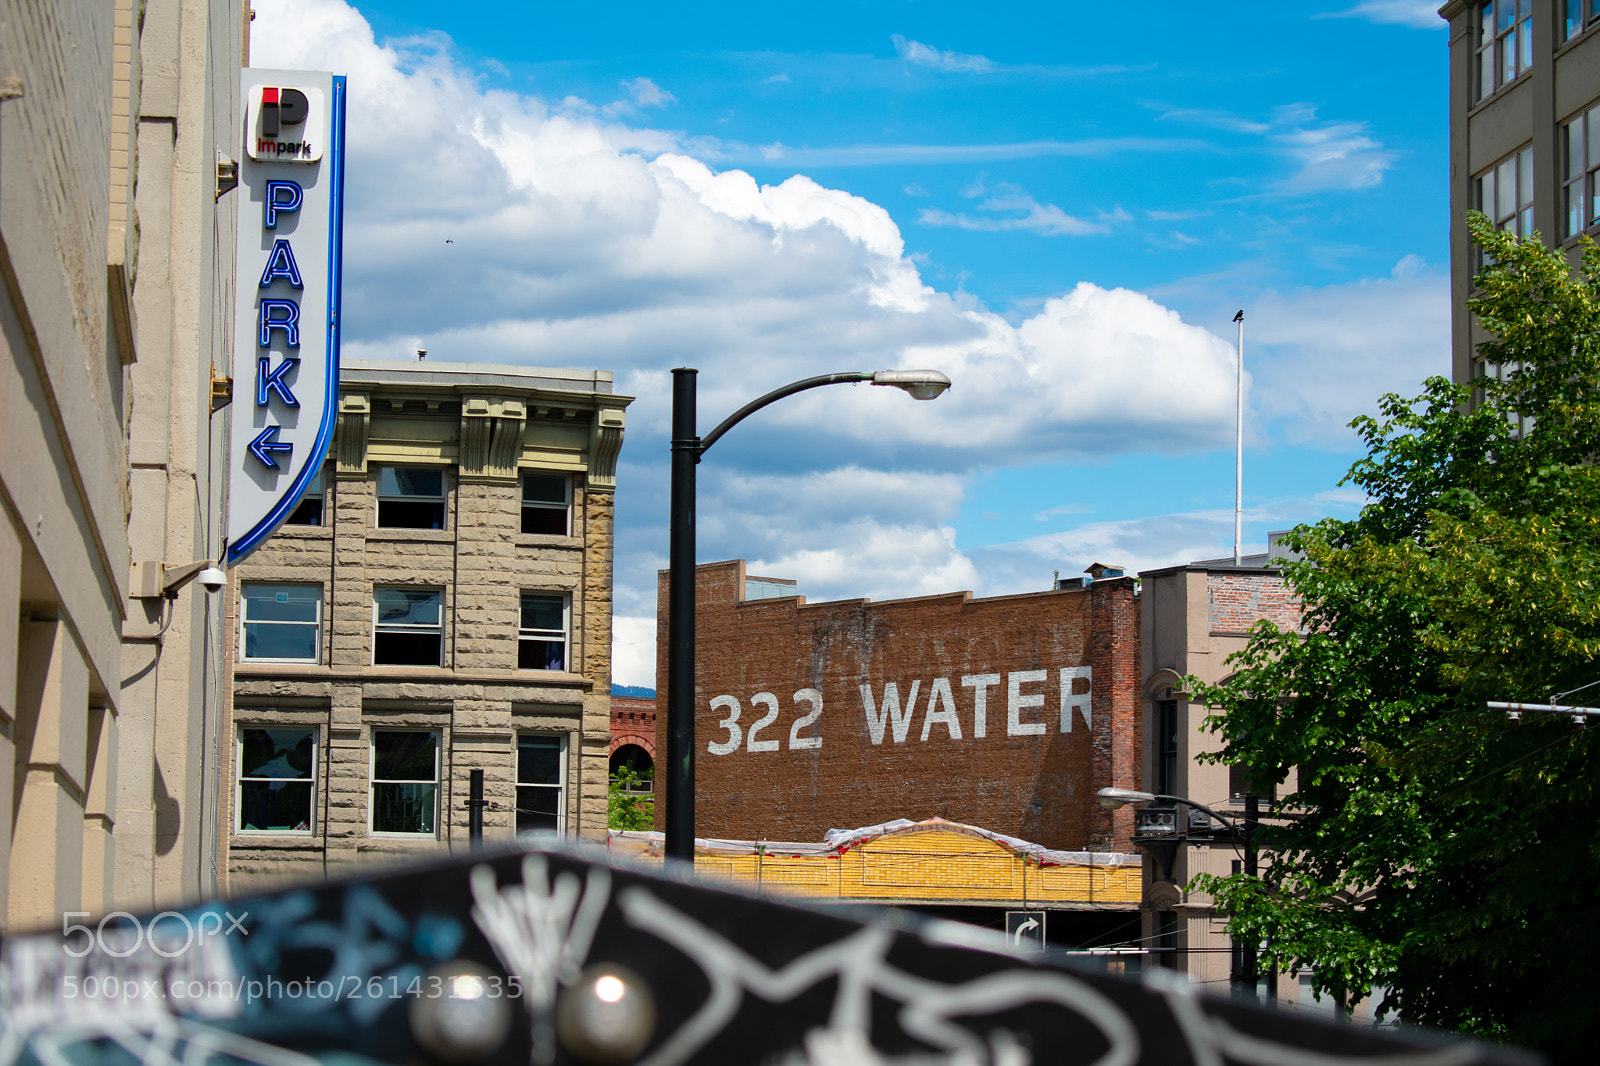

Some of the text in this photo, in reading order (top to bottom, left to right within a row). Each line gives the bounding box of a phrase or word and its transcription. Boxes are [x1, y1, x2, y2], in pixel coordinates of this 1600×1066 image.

[257, 138, 312, 156] impark
[257, 179, 305, 407] PARK
[707, 666, 1092, 755] 322 WATER
